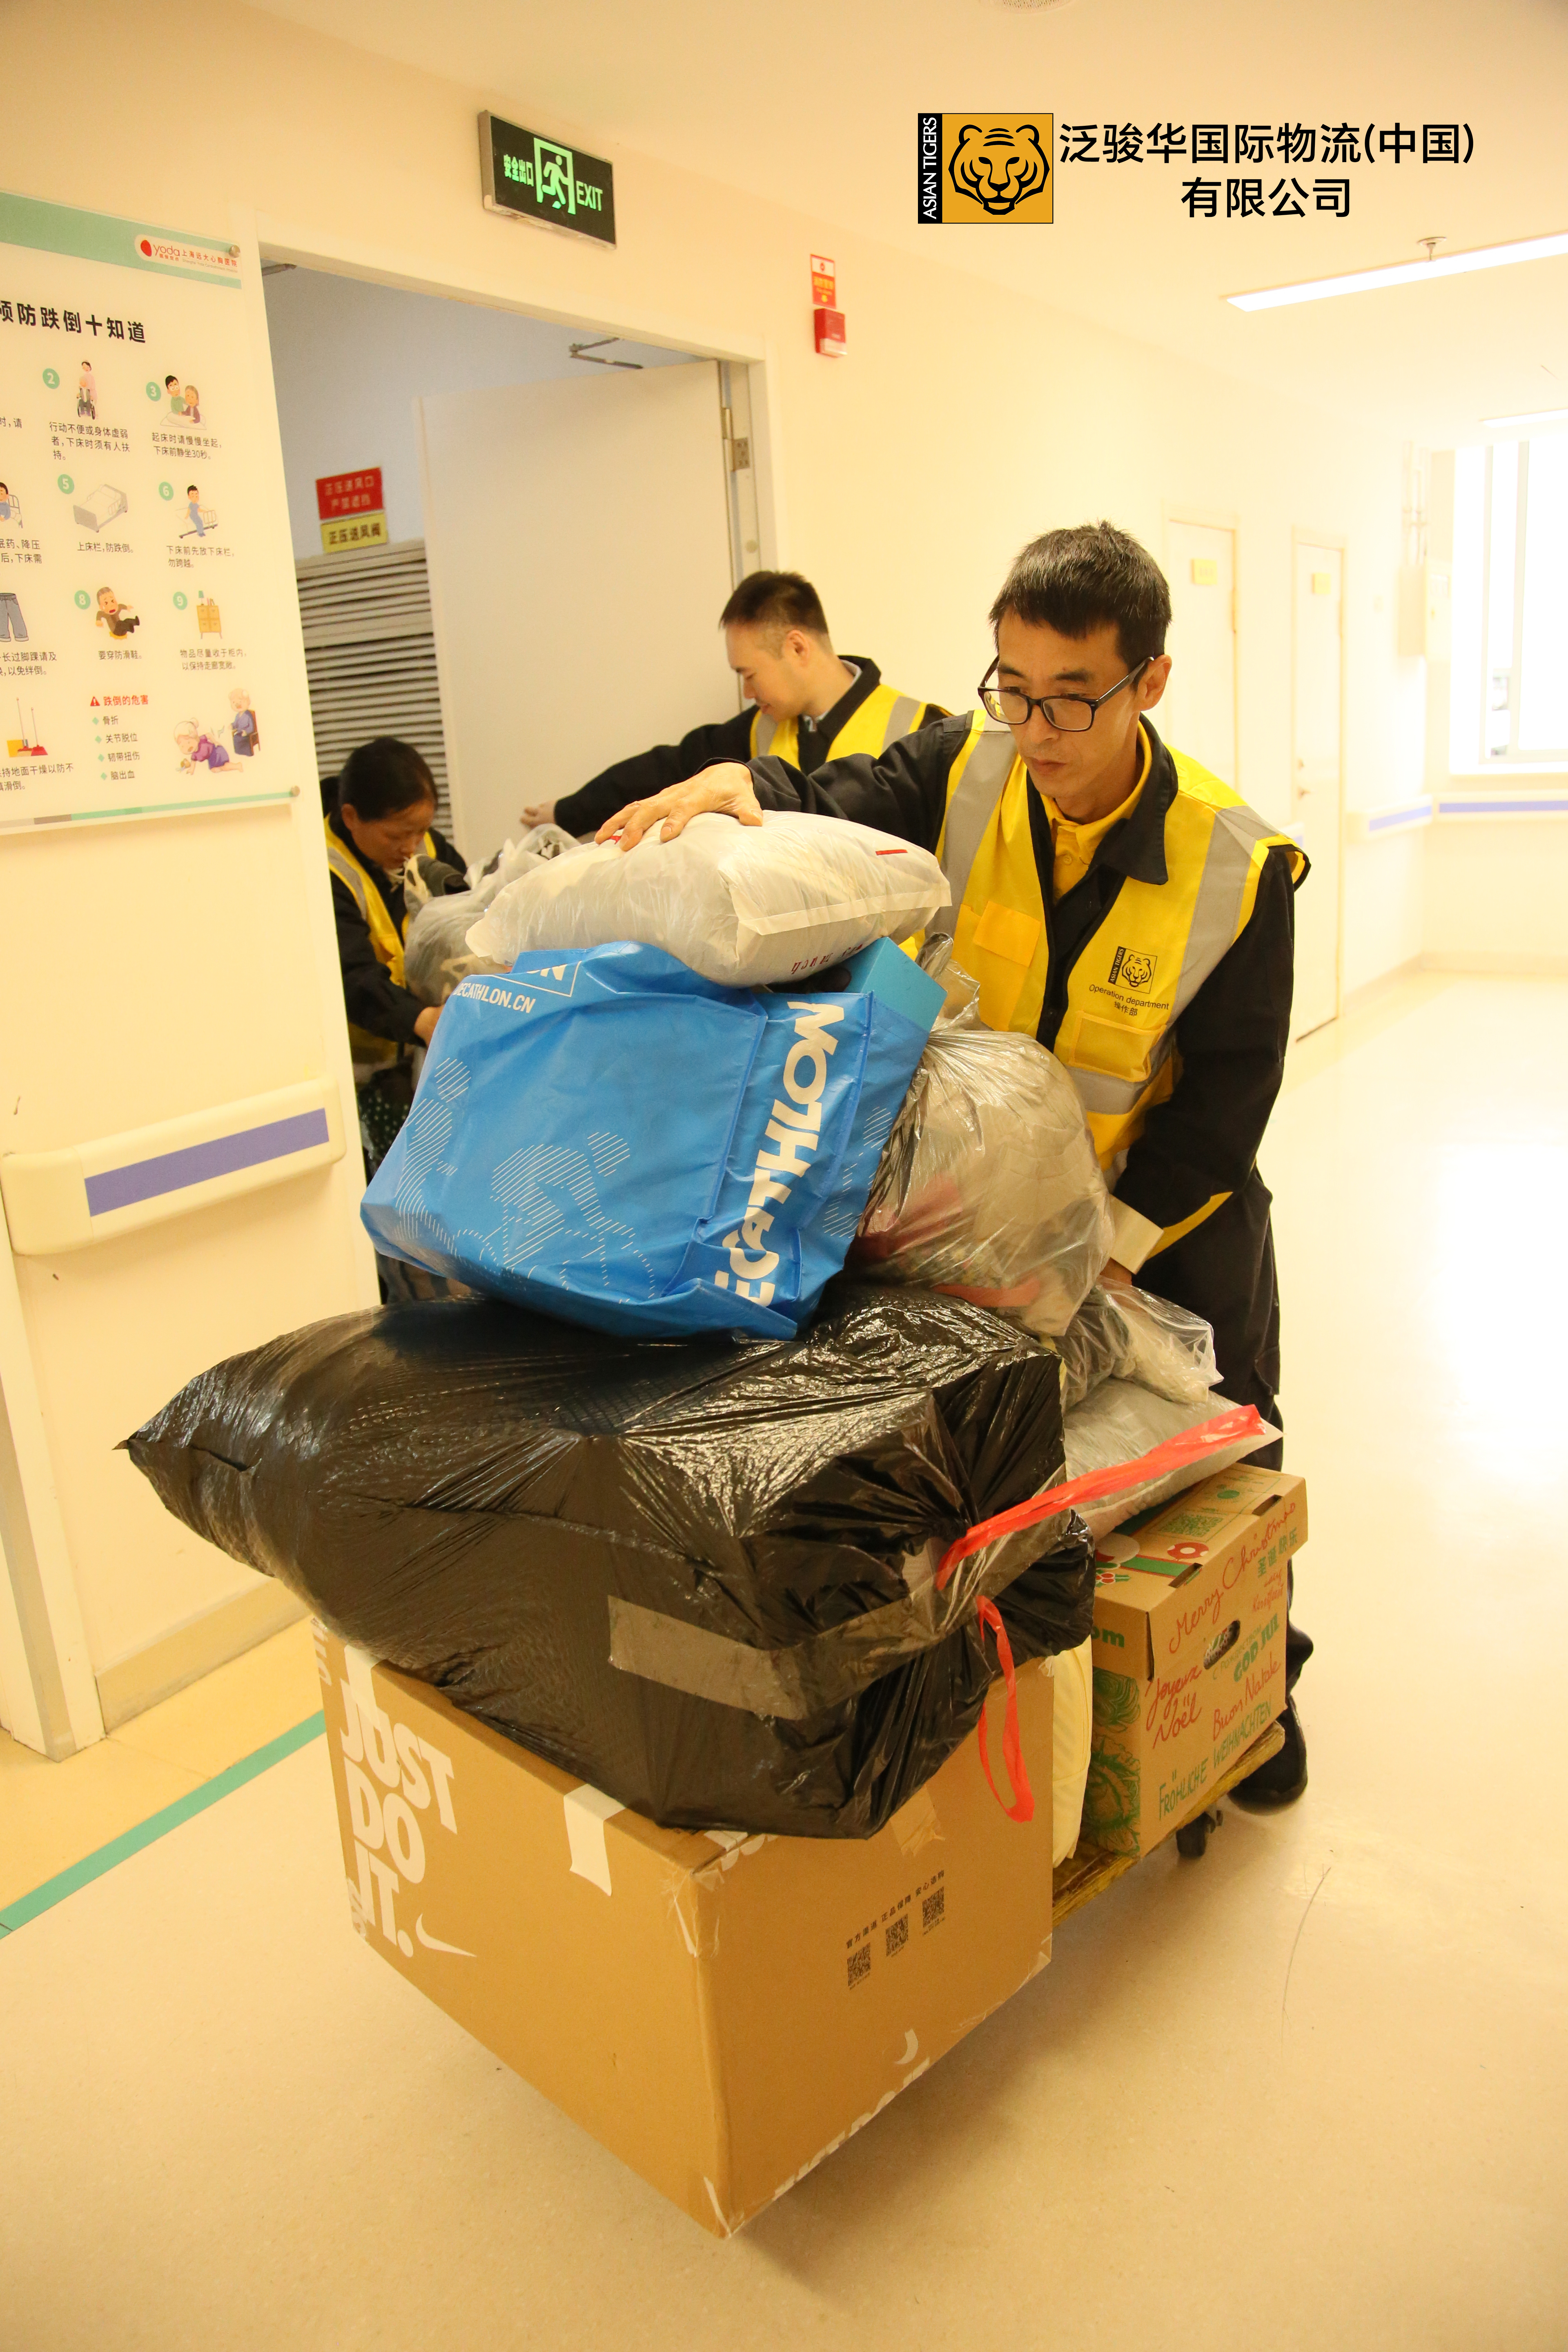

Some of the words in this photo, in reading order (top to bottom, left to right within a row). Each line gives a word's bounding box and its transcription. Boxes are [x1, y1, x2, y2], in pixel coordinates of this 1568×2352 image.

[503, 154, 534, 187] 安全出口
[576, 180, 603, 211] EXIT
[154, 245, 180, 256] yoda
[182, 249, 237, 267] 上海远大心胸医院
[47, 373, 55, 385] 2
[151, 386, 157, 396] 3
[49, 421, 128, 439] 行动不便或身体虚弱
[62, 478, 69, 490] 5
[163, 486, 169, 496] 6
[79, 594, 86, 606] 8
[176, 596, 183, 606] 9
[0, 652, 57, 662] 长过脚踝请及
[103, 695, 148, 706] 跌倒的危害
[103, 715, 118, 725] 骨折
[106, 733, 138, 743] 关节脱位
[108, 751, 140, 762] 韧带扭伤
[0, 763, 74, 777] 持地面干燥以防不
[111, 770, 135, 780] 脑出血
[1109, 967, 1118, 982] ASIAN
[1115, 948, 1124, 966] TIGERS
[453, 982, 536, 1013] DECATHLON.CN
[1089, 984, 1124, 1001] Operation
[1126, 996, 1169, 1010] department
[1114, 1001, 1138, 1016] 操作部
[1258, 1527, 1298, 1579] 圣诞快乐
[1169, 1589, 1224, 1654] Merry
[1223, 1502, 1295, 1590] Christmas
[1234, 1640, 1258, 1682] GOD
[1261, 1613, 1280, 1650] JUL
[1145, 1665, 1202, 1731] Joyeux
[1213, 1699, 1243, 1742] Buon
[1245, 1650, 1281, 1706] Natale
[1153, 1692, 1202, 1749] Noël
[1213, 1694, 1272, 1770] WEIHNACHTEN
[340, 1678, 458, 1835] JUST
[344, 1756, 425, 1884] DO
[354, 1839, 414, 1958] IT.
